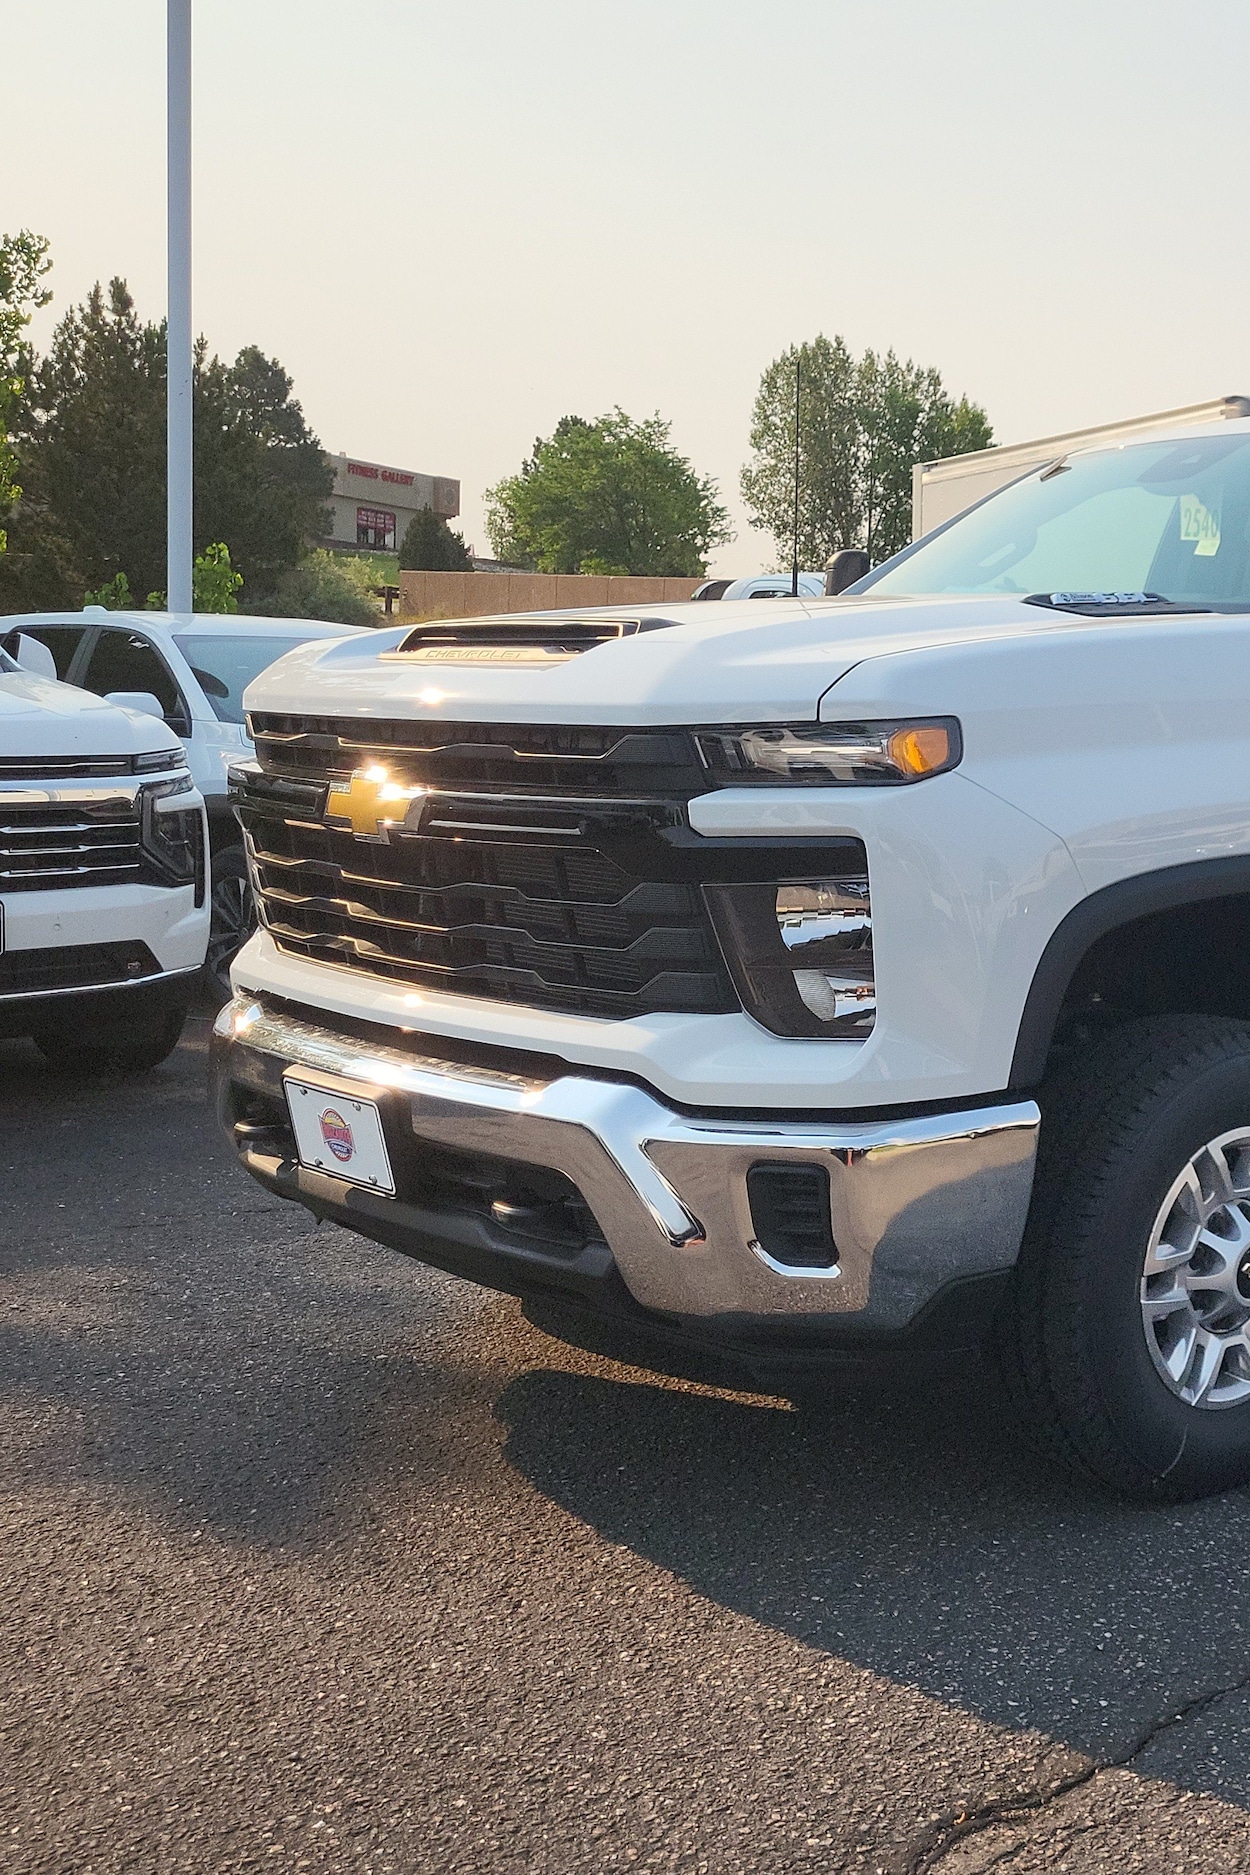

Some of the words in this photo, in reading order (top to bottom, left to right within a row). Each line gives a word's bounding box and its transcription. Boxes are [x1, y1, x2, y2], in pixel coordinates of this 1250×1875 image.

[347, 463, 379, 479] FITNESS
[381, 470, 415, 486] GALLERY
[425, 649, 528, 659] CHEVROLET
